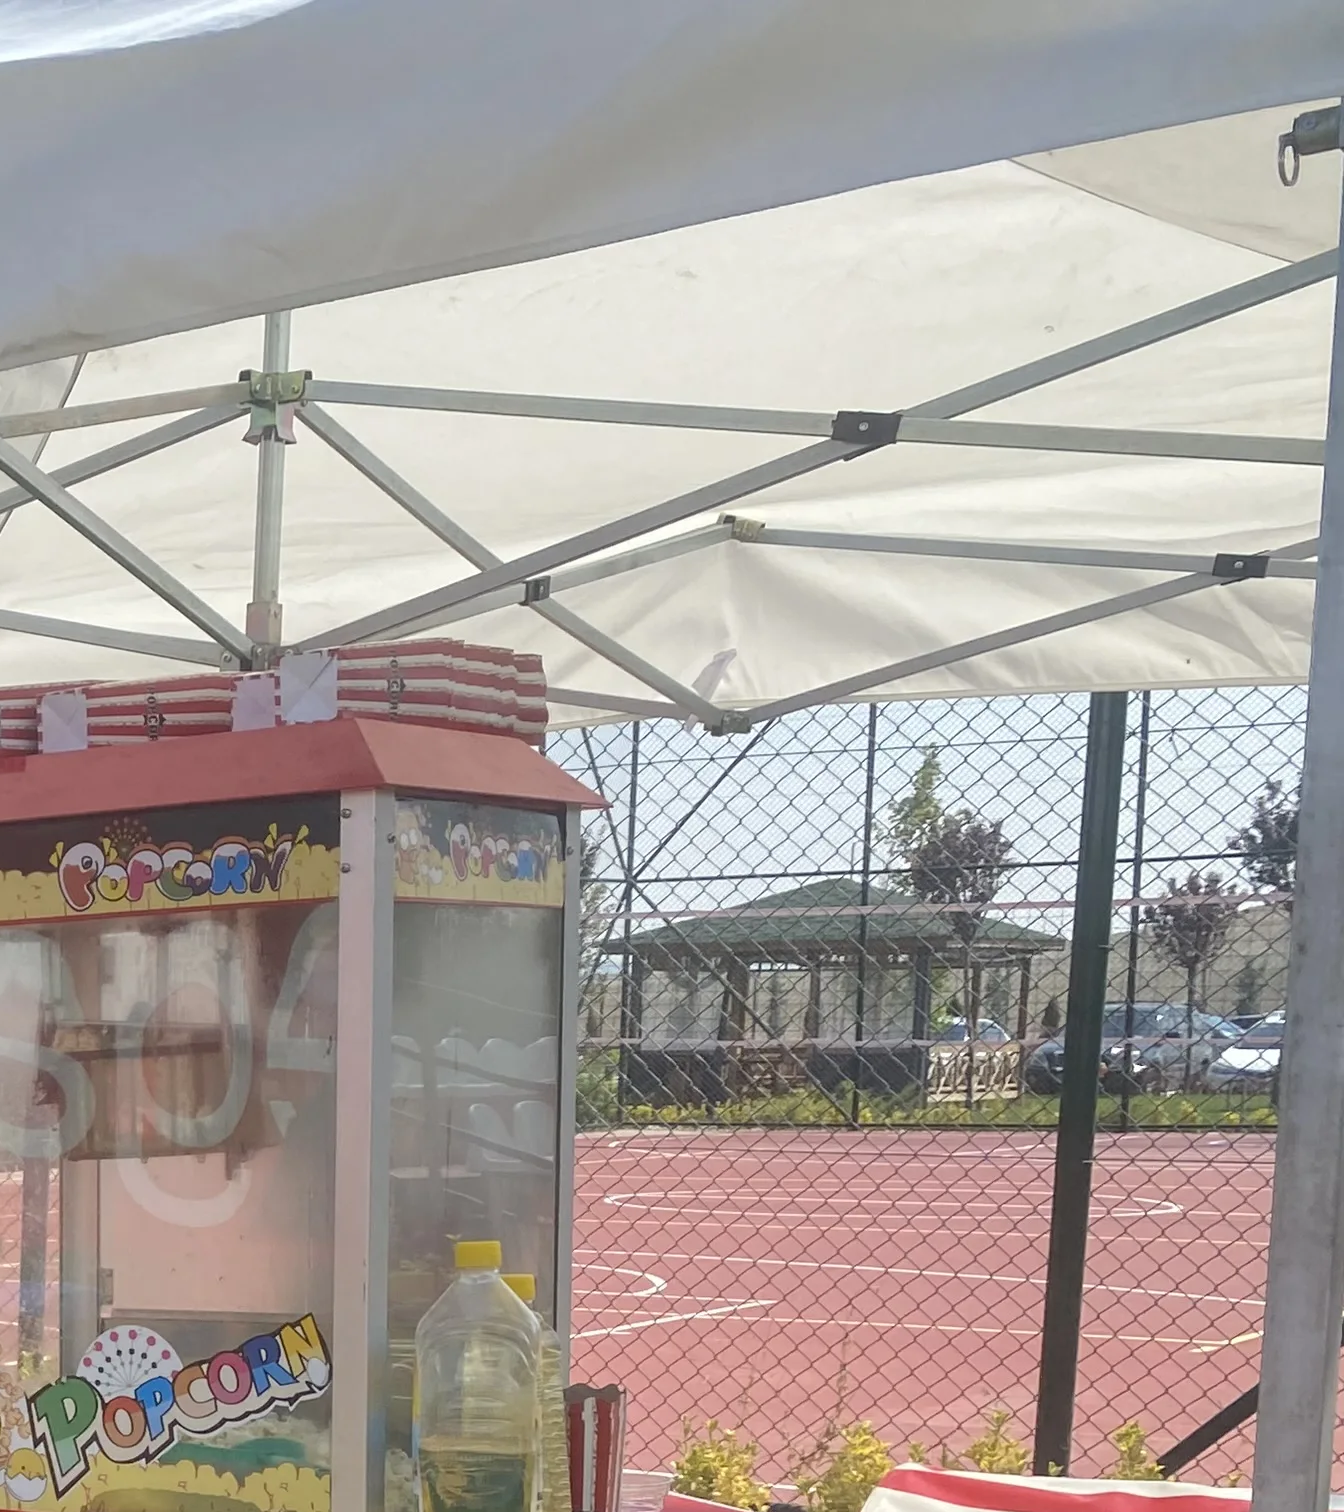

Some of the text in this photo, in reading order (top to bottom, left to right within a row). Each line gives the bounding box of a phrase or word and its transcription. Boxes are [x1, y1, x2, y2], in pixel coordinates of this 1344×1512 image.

[57, 836, 295, 911] POPCORN
[450, 822, 552, 882] POPCORN
[29, 1313, 327, 1488] POPCORN
